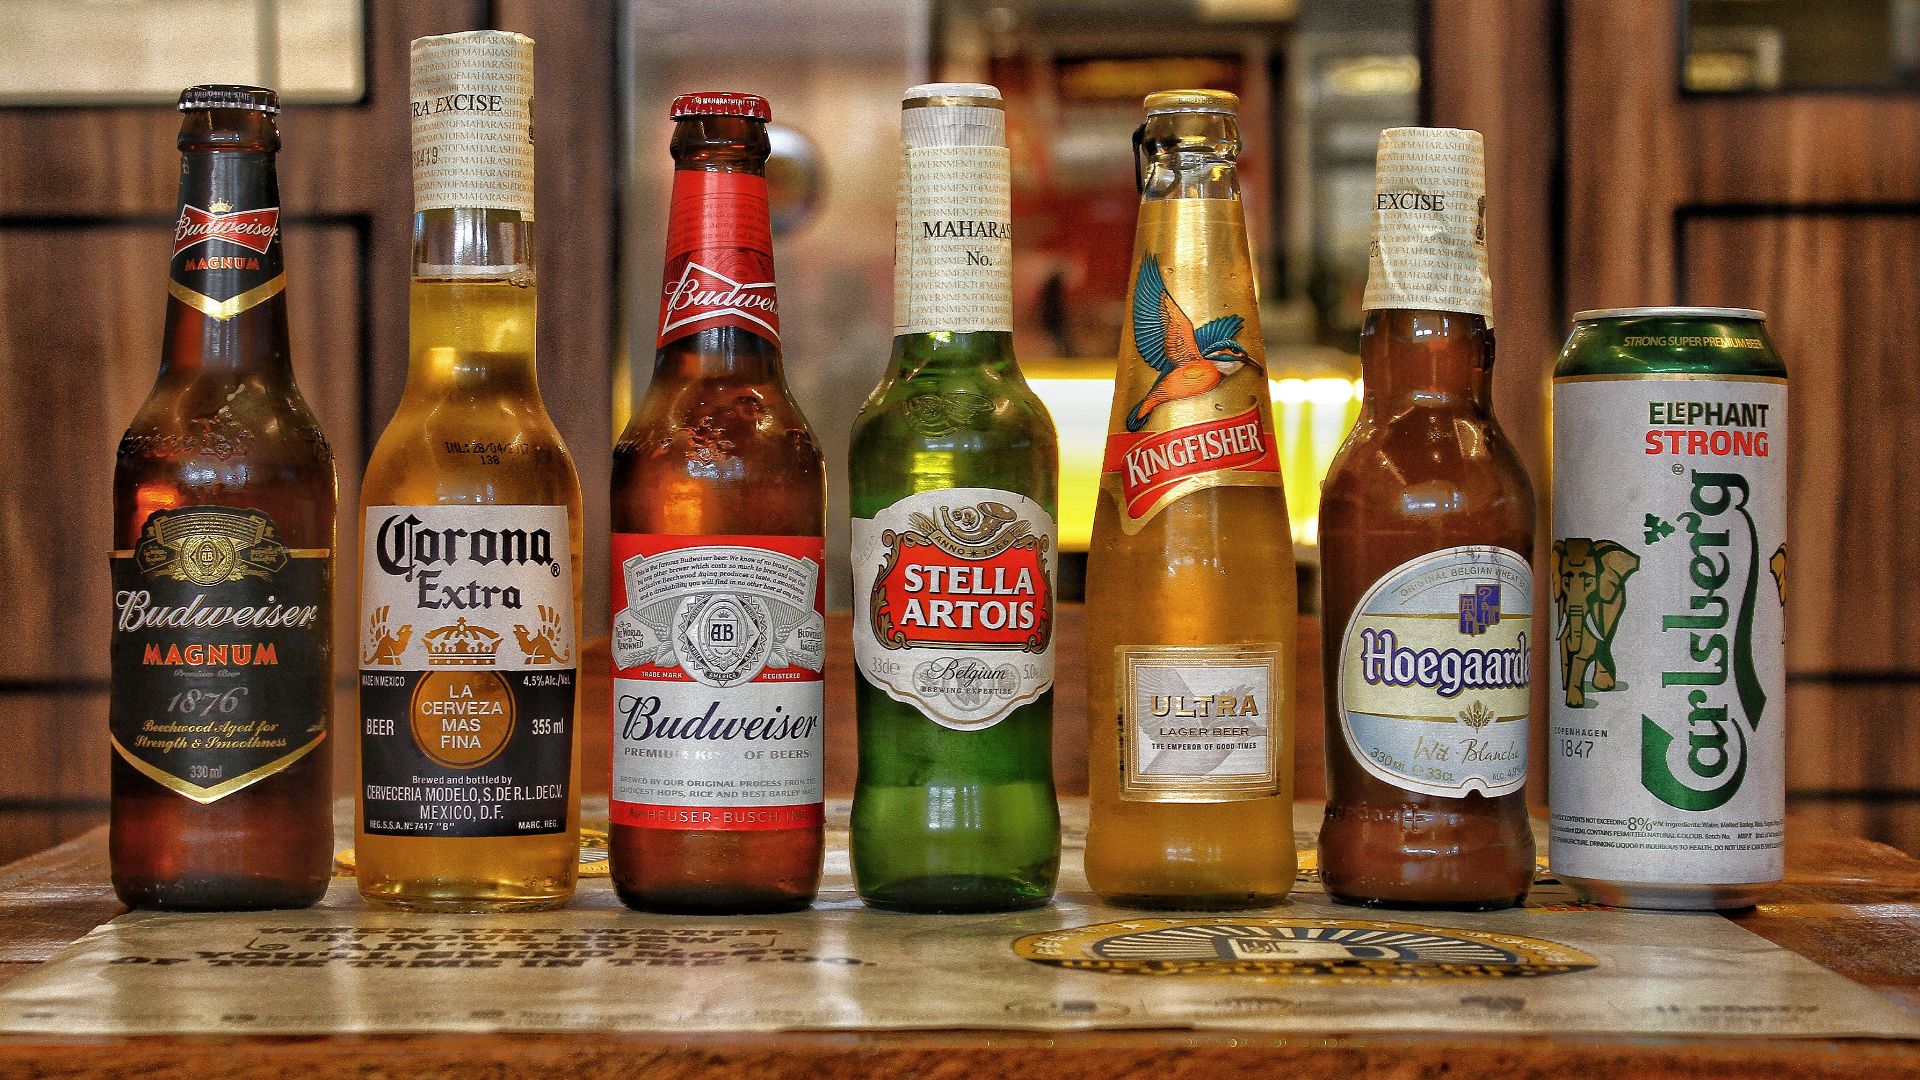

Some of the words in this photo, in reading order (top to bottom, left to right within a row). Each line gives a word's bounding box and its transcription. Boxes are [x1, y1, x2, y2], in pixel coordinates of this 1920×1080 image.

[434, 93, 502, 115] EXCISE
[1377, 192, 1445, 212] EXCISE
[175, 214, 279, 242] Budweiser
[184, 256, 260, 271] MAGNUM
[967, 250, 993, 267] No.
[1624, 336, 1667, 347] STRONG
[1668, 336, 1702, 347] SUPER
[1703, 337, 1746, 349] PREMIUM
[1746, 339, 1764, 350] BEER
[1645, 430, 1769, 457] STRONG
[480, 455, 501, 465] 138
[1125, 420, 1265, 488] KINGFISHER
[376, 513, 554, 582] Corona
[935, 535, 966, 556] ANNO
[983, 539, 1010, 556] 1366
[904, 564, 1035, 596] STELLA
[1451, 566, 1492, 577] BELGIAN
[416, 570, 523, 610] Extra
[116, 590, 317, 632] Budweiser
[900, 598, 1035, 630] ARTOIS
[1641, 469, 1767, 812] Carlsberg
[142, 643, 278, 666] MAGNUM
[762, 672, 801, 680] REGISTERED
[926, 656, 1006, 688] Belgium
[380, 676, 406, 688] MEXICO
[921, 686, 962, 694] BREWING
[966, 686, 1012, 695] EXPERTISE
[449, 684, 474, 699] LA
[166, 686, 248, 718] 1876
[420, 702, 504, 716] CERVEZA
[1150, 694, 1259, 718] ULTRA
[442, 718, 481, 732] MAS
[618, 694, 818, 741] Budweiser
[142, 719, 214, 734] Beechwood
[216, 720, 256, 739] Aged
[256, 720, 280, 738] for
[366, 718, 395, 736] BEER
[532, 718, 552, 735] 355
[552, 718, 564, 734] ml
[1160, 727, 1208, 736] LAGER
[1212, 727, 1250, 736] BEER
[134, 734, 190, 754] Strength
[192, 736, 201, 749] &
[204, 734, 287, 749] Smoothness
[440, 736, 482, 749] FINA
[1152, 742, 1165, 750] THE
[1204, 742, 1214, 750] OF
[1216, 742, 1235, 750] GOOD
[1237, 742, 1257, 750] TIMES
[1413, 736, 1450, 763] Wit
[1459, 738, 1521, 765] Blanche
[1560, 739, 1594, 759] 1847
[744, 750, 764, 760] OF
[770, 750, 810, 760] BEERS
[1370, 747, 1392, 766] 330
[190, 766, 208, 778] 330
[412, 776, 445, 785] Brewed
[446, 776, 464, 785] and
[466, 776, 500, 785] bottled
[501, 776, 512, 786] by
[650, 778, 662, 786] BY
[663, 778, 684, 787] OUR
[686, 780, 736, 788] ORIGINAL
[739, 780, 782, 788] PROCESS
[784, 778, 802, 786] FROM
[367, 785, 422, 802] CERVECERIA
[425, 786, 480, 804] MODELO,
[496, 787, 512, 802] DE
[536, 786, 548, 800] DE
[656, 788, 686, 798] HOPS,
[688, 790, 714, 798] RICE
[716, 790, 739, 798] AND
[741, 790, 767, 798] BEST
[769, 788, 800, 798] BARLEY
[420, 804, 476, 822] MEXICO,
[480, 804, 504, 820] D.F.
[518, 820, 543, 830] MARC.
[544, 820, 559, 830] REG.
[1597, 818, 1628, 826] EXCEEDING
[1628, 816, 1653, 832] 8%
[1590, 840, 1616, 848] DRINKING
[386, 934, 537, 942] YOUR
[558, 934, 725, 944] BREW
[580, 928, 783, 936] WATER
[327, 942, 499, 951] AIN'T
[415, 950, 615, 959] SPEND
[633, 948, 808, 958] MOST
[108, 956, 191, 965] OF
[207, 959, 329, 968] THE
[346, 960, 502, 968] TIME
[520, 958, 588, 968] IN
[608, 958, 727, 967] THE
